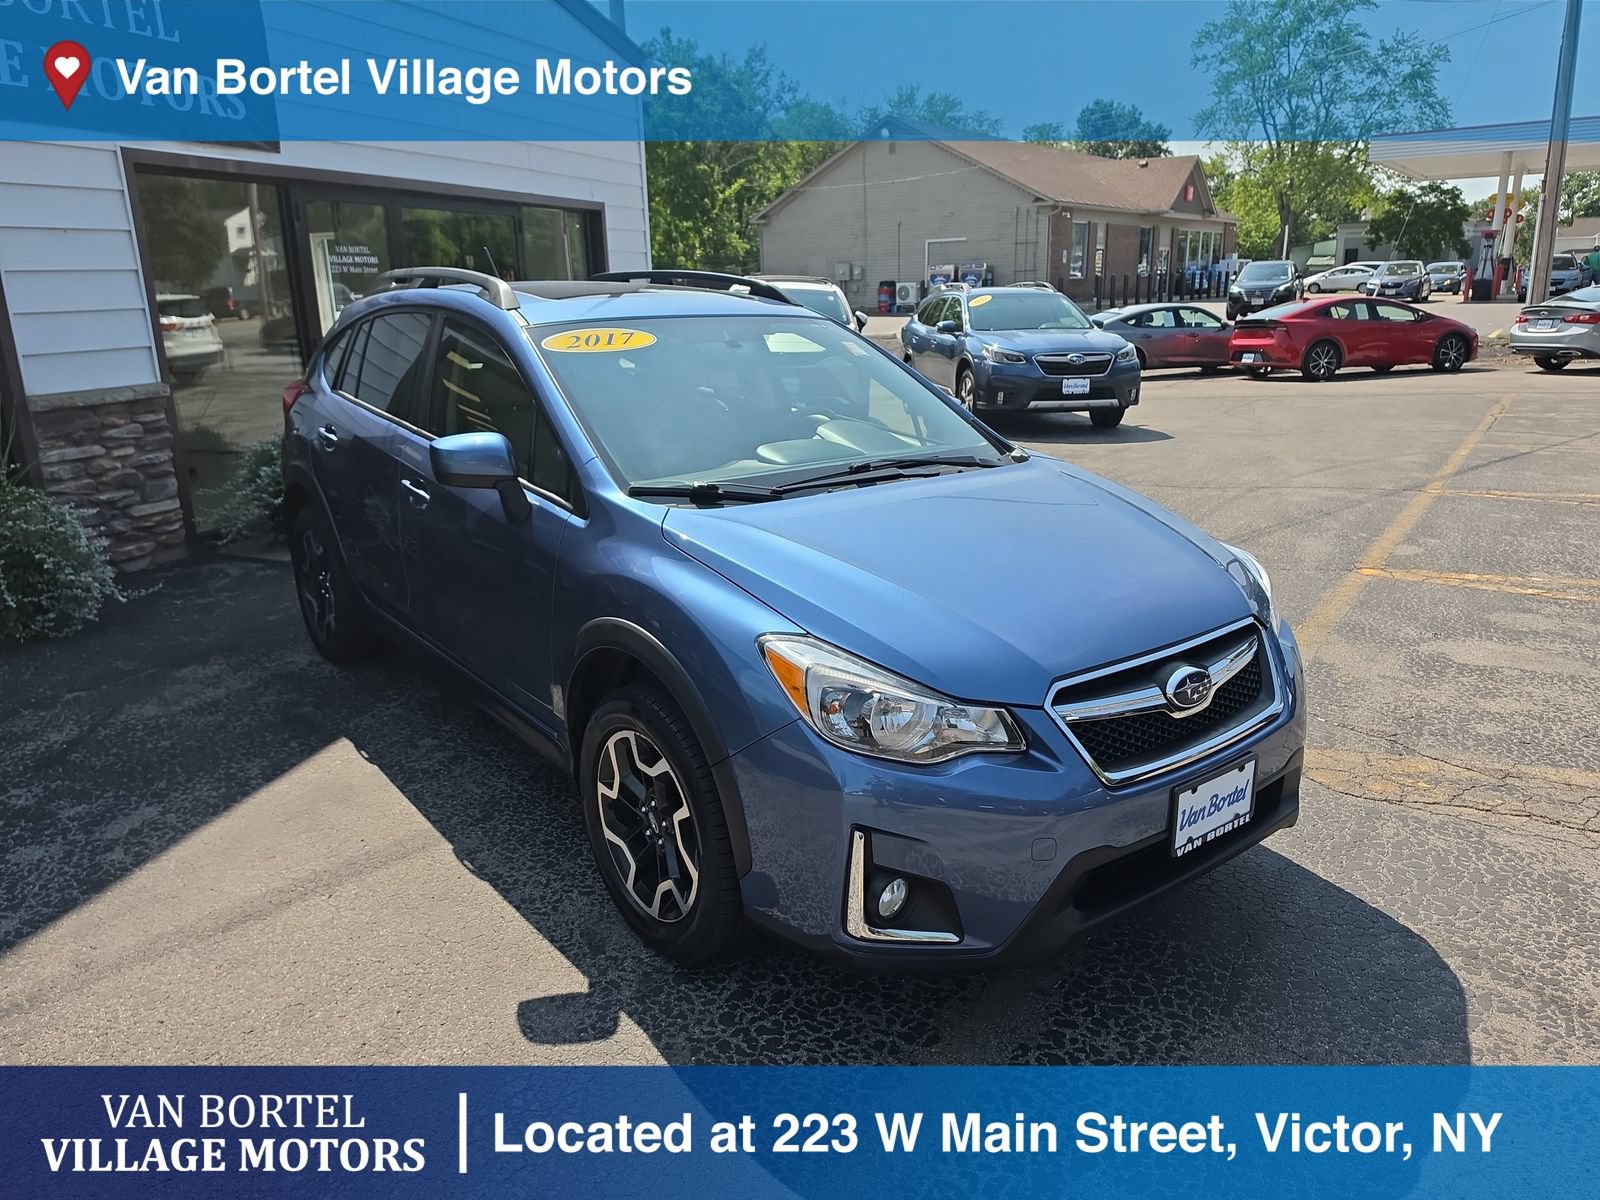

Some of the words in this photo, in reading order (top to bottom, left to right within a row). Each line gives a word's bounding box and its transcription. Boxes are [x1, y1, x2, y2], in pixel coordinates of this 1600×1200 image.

[40, 46, 247, 120] OTORS
[329, 255, 353, 263] VILLAGE
[354, 255, 379, 264] MOTORS
[567, 332, 635, 349] 2017
[1179, 804, 1207, 832] Van
[1206, 778, 1250, 818] Bortel
[1176, 837, 1203, 858] VAN
[1206, 813, 1251, 842] BORTEL
